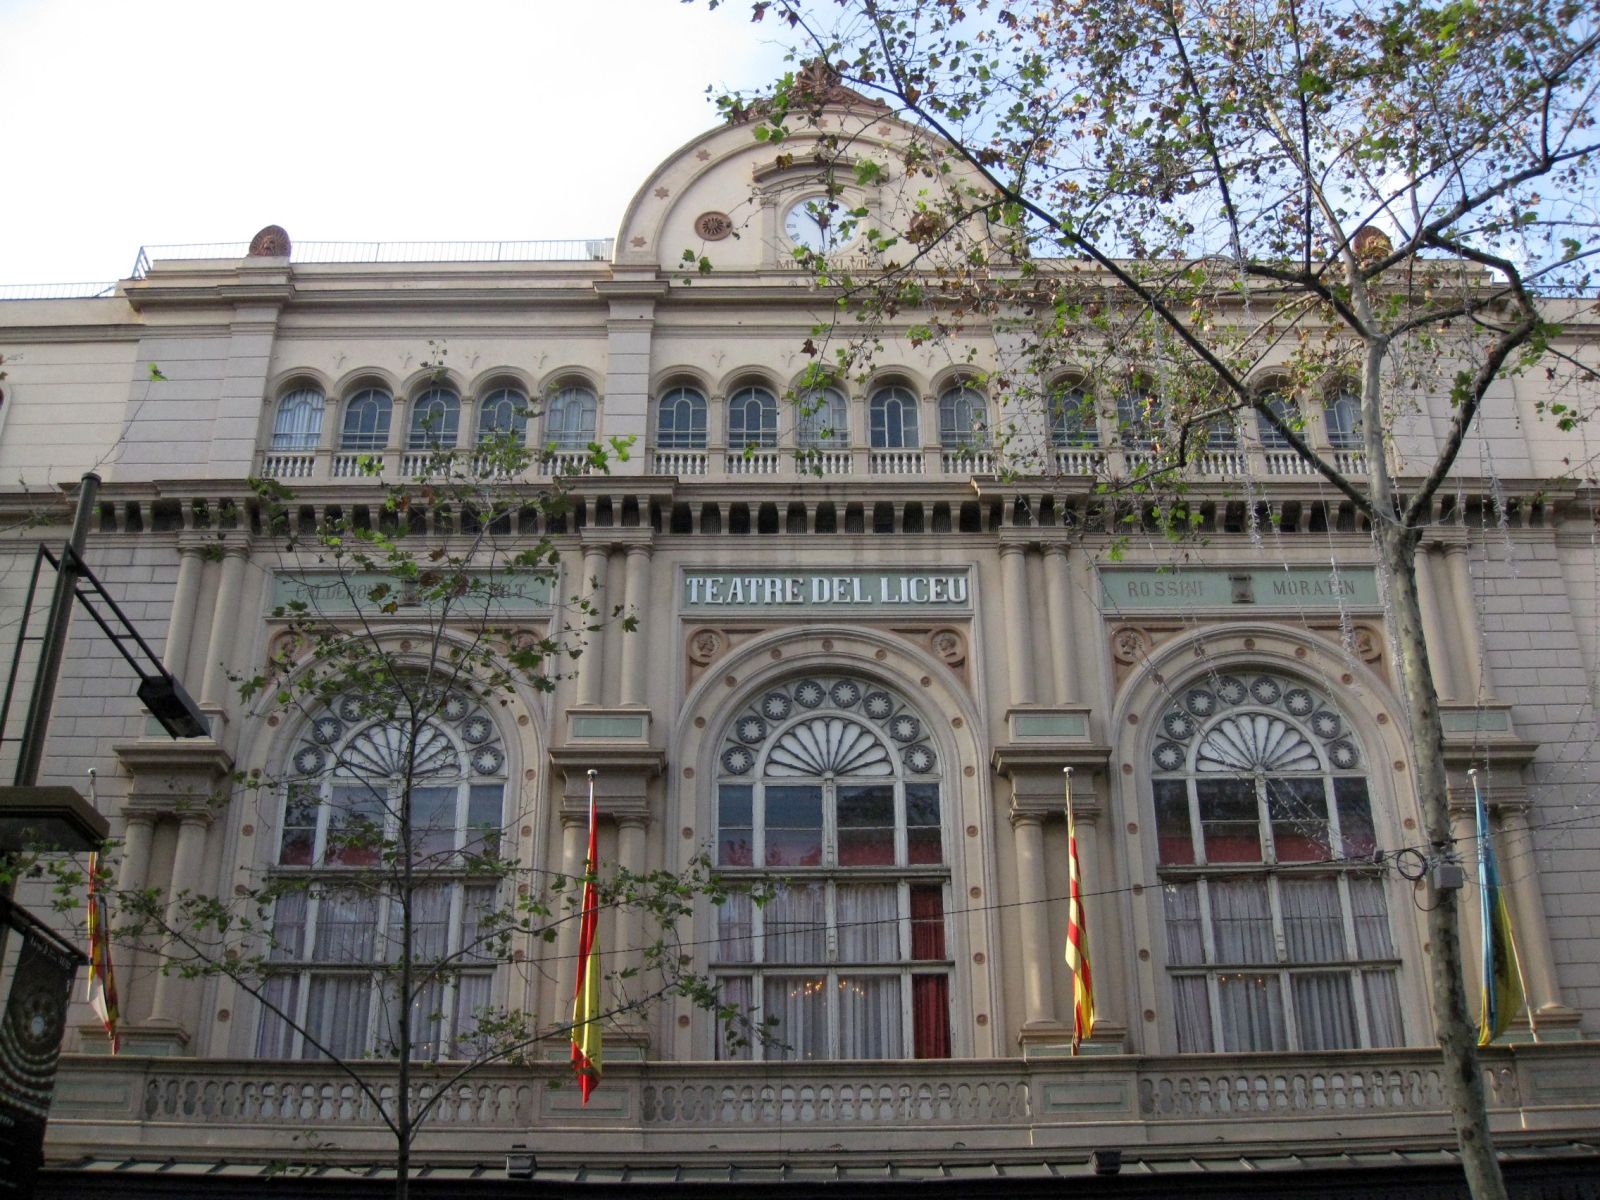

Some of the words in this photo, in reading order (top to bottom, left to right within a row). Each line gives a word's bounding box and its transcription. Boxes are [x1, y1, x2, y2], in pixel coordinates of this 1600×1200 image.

[296, 584, 375, 600] CALDERO
[686, 577, 804, 604] TEATRE
[811, 577, 872, 604] DEL
[881, 576, 968, 604] LICEU
[1127, 580, 1203, 598] ROSSINI
[1273, 580, 1355, 596] MORATIN
